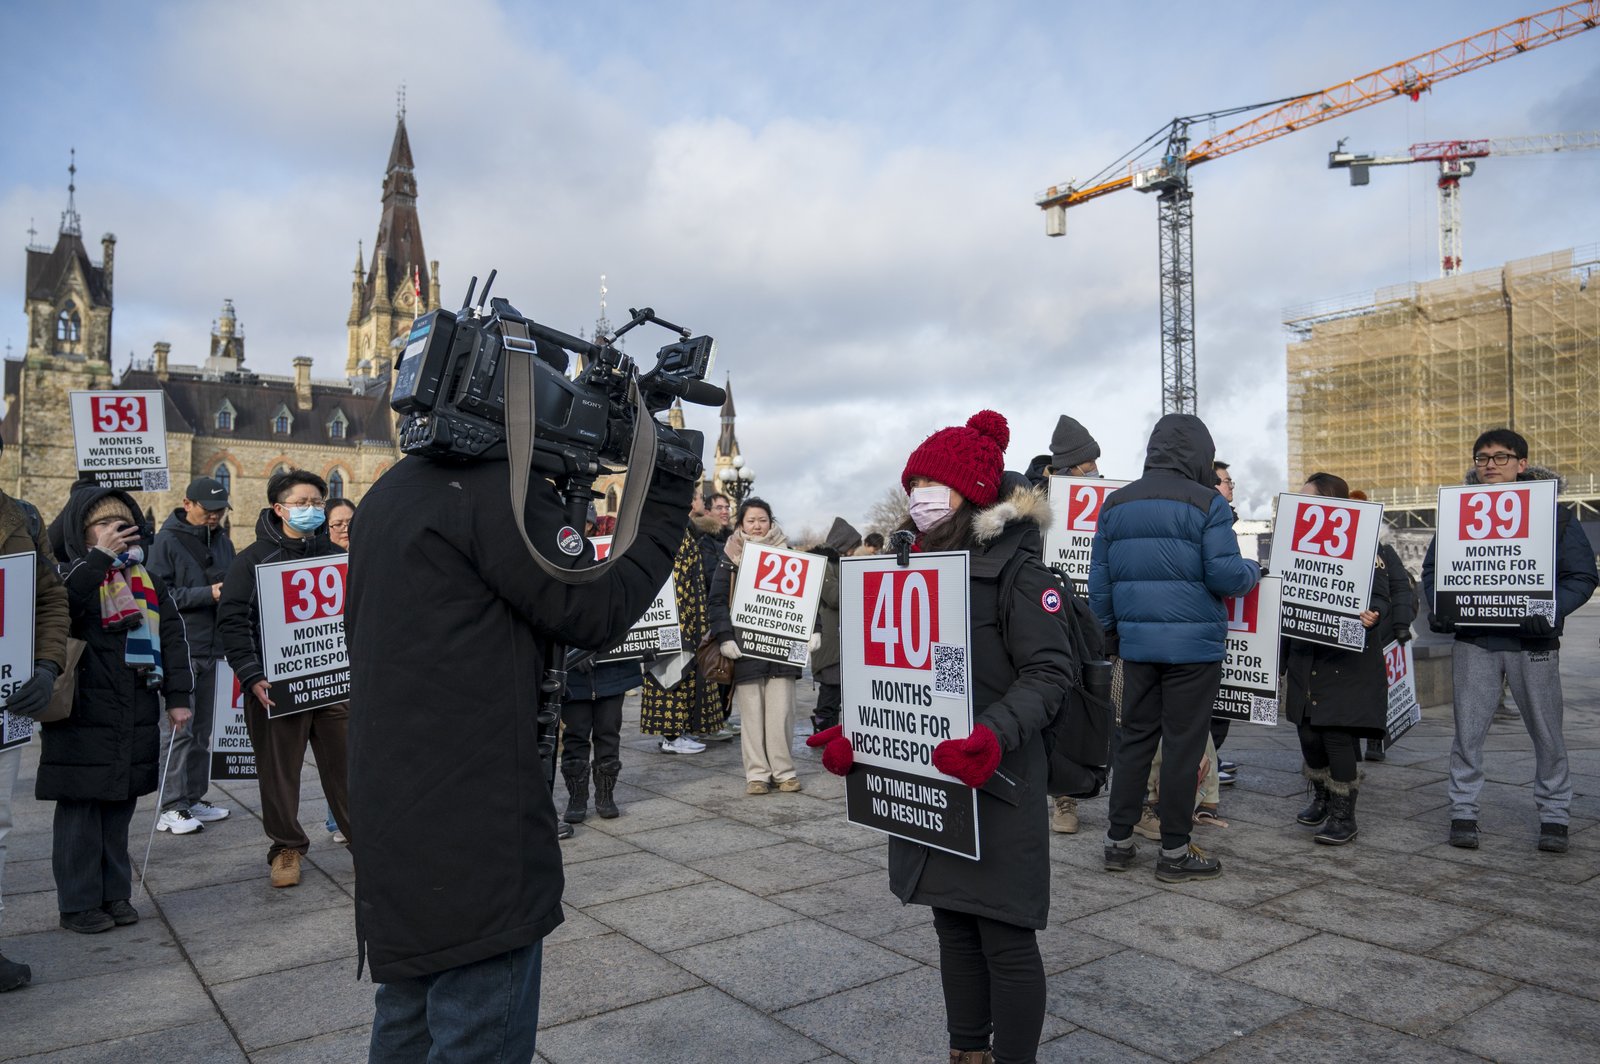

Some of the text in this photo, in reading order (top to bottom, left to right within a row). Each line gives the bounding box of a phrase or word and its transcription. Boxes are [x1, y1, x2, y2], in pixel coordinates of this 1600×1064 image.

[98, 398, 142, 432] 53
[99, 436, 143, 446] MONTHS
[89, 446, 155, 457] WAITING FOR
[83, 456, 162, 467] IRCC RESPONSE
[95, 472, 108, 481] NO
[99, 481, 112, 489] NO
[1466, 491, 1522, 539] 39
[1297, 505, 1351, 557] 23
[1465, 545, 1522, 557] MONTHS
[1294, 558, 1344, 576] MONTHS
[1451, 559, 1537, 572] WAITING FOR
[758, 553, 803, 595] 28
[1281, 570, 1355, 594] WAITING FOR
[1443, 574, 1545, 586] IRCC RESPONSE
[291, 565, 344, 620] 39
[1297, 588, 1361, 609] RESPONSE
[1455, 595, 1530, 605] NO TIMELINES
[756, 594, 795, 609] MONTHS
[744, 603, 804, 623] WAITING FOR
[870, 571, 931, 668] 40
[1281, 605, 1340, 626] NO TIMELINE
[1460, 607, 1526, 617] NO RESULTS
[294, 622, 345, 641] MONTHS
[735, 613, 807, 635] IRCC RESPONSE
[1282, 617, 1339, 638] NO RESULTS
[626, 629, 659, 641] MELINE
[741, 631, 753, 641] NO
[280, 638, 330, 659] WAITING
[623, 640, 660, 652] RESULTS
[743, 641, 789, 657] NO RESULTS
[274, 660, 304, 676] IRCC
[1237, 655, 1262, 668] FOR
[289, 670, 350, 693] NO TIMELINE
[294, 693, 310, 705] NO
[871, 680, 932, 707] MONTHS
[225, 726, 248, 735] WAIT
[858, 705, 951, 741] WAITING FOR
[218, 738, 239, 748] IRCC
[852, 731, 935, 767] IRCC RESPO
[226, 755, 237, 764] NO
[228, 765, 240, 774] NO
[866, 773, 947, 809] NO TIMELINES
[872, 797, 943, 832] NO RESULTS
